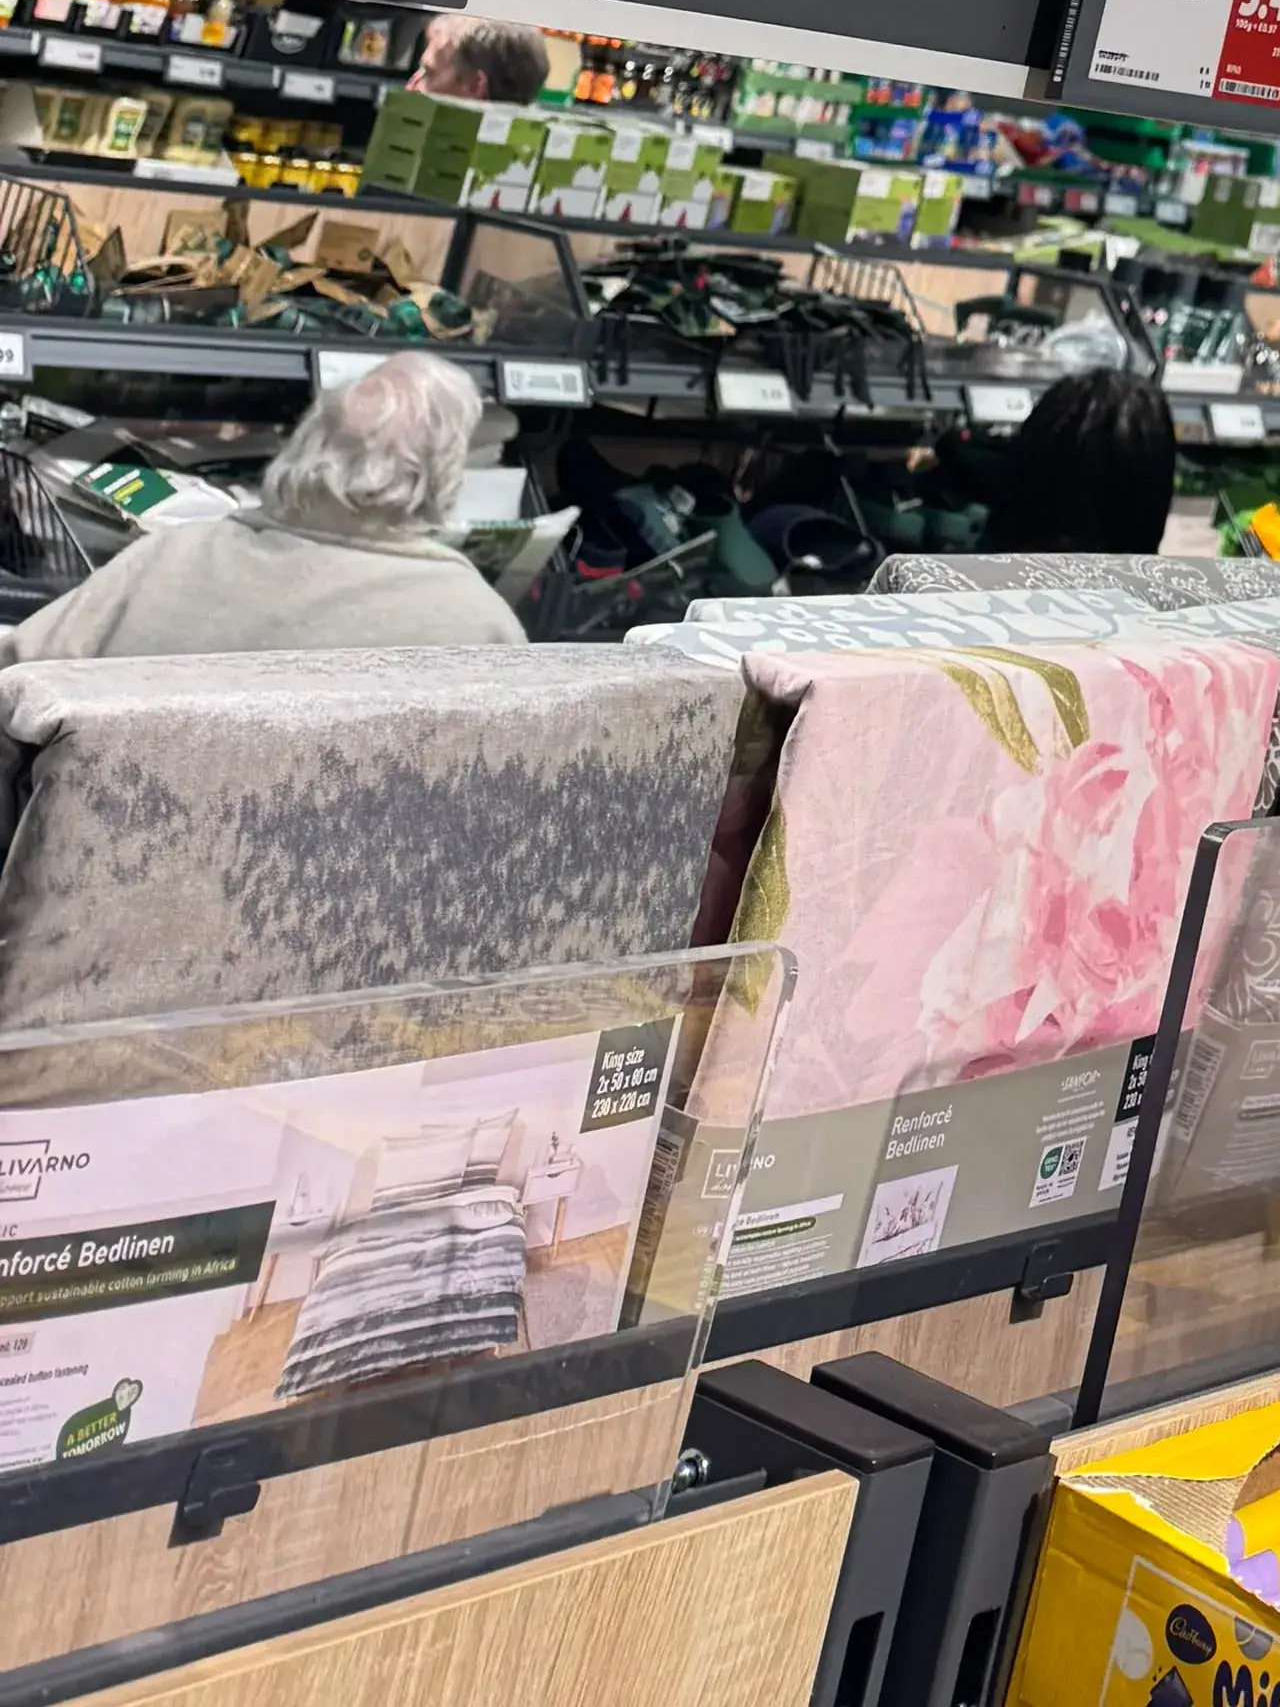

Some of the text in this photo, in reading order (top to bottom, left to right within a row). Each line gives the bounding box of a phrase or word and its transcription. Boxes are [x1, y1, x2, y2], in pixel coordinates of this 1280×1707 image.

[601, 1045, 645, 1072] King size
[596, 1074, 609, 1095] 2x
[610, 1073, 623, 1092] 50
[624, 1077, 630, 1090] x
[643, 1065, 659, 1083] cm
[591, 1091, 652, 1119] 230 x 220 cm
[891, 1104, 954, 1136] Renforcé
[885, 1130, 946, 1161] Bedlinen
[77, 1234, 175, 1268] Bedlinen
[37, 1282, 105, 1303] sustainable
[108, 1275, 144, 1292] cotton
[147, 1265, 190, 1285] farming
[191, 1264, 202, 1277] in
[203, 1257, 236, 1275] Africa
[76, 1412, 118, 1444] BETTER
